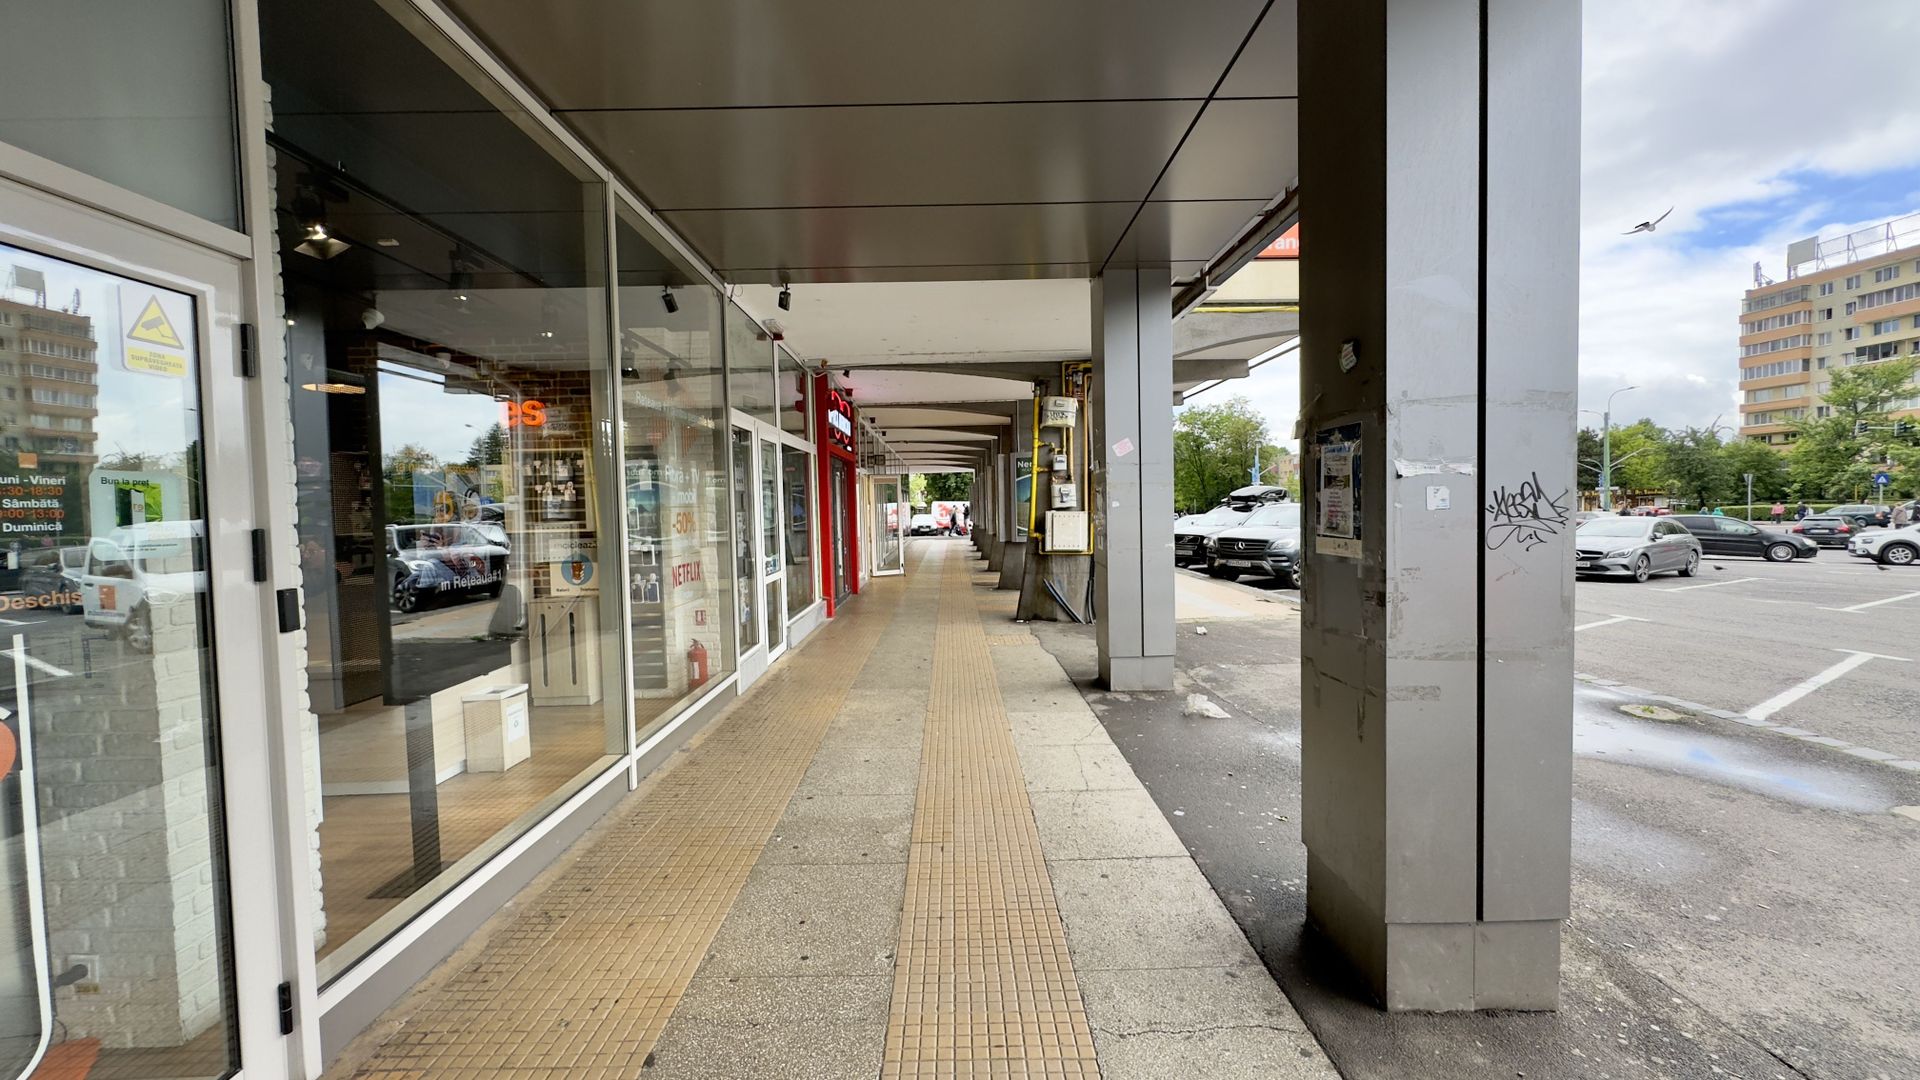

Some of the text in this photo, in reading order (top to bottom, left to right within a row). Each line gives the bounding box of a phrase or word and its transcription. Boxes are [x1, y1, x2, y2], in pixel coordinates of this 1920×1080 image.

[1268, 237, 1299, 250] an
[100, 477, 119, 485] Bun
[0, 486, 64, 496] :30-18:30
[2, 499, 60, 508] Sâmbătă
[2, 522, 63, 532] Duminică
[672, 511, 697, 534] -50%
[672, 560, 701, 589] NETFLIX
[0, 589, 83, 611] Deschis
